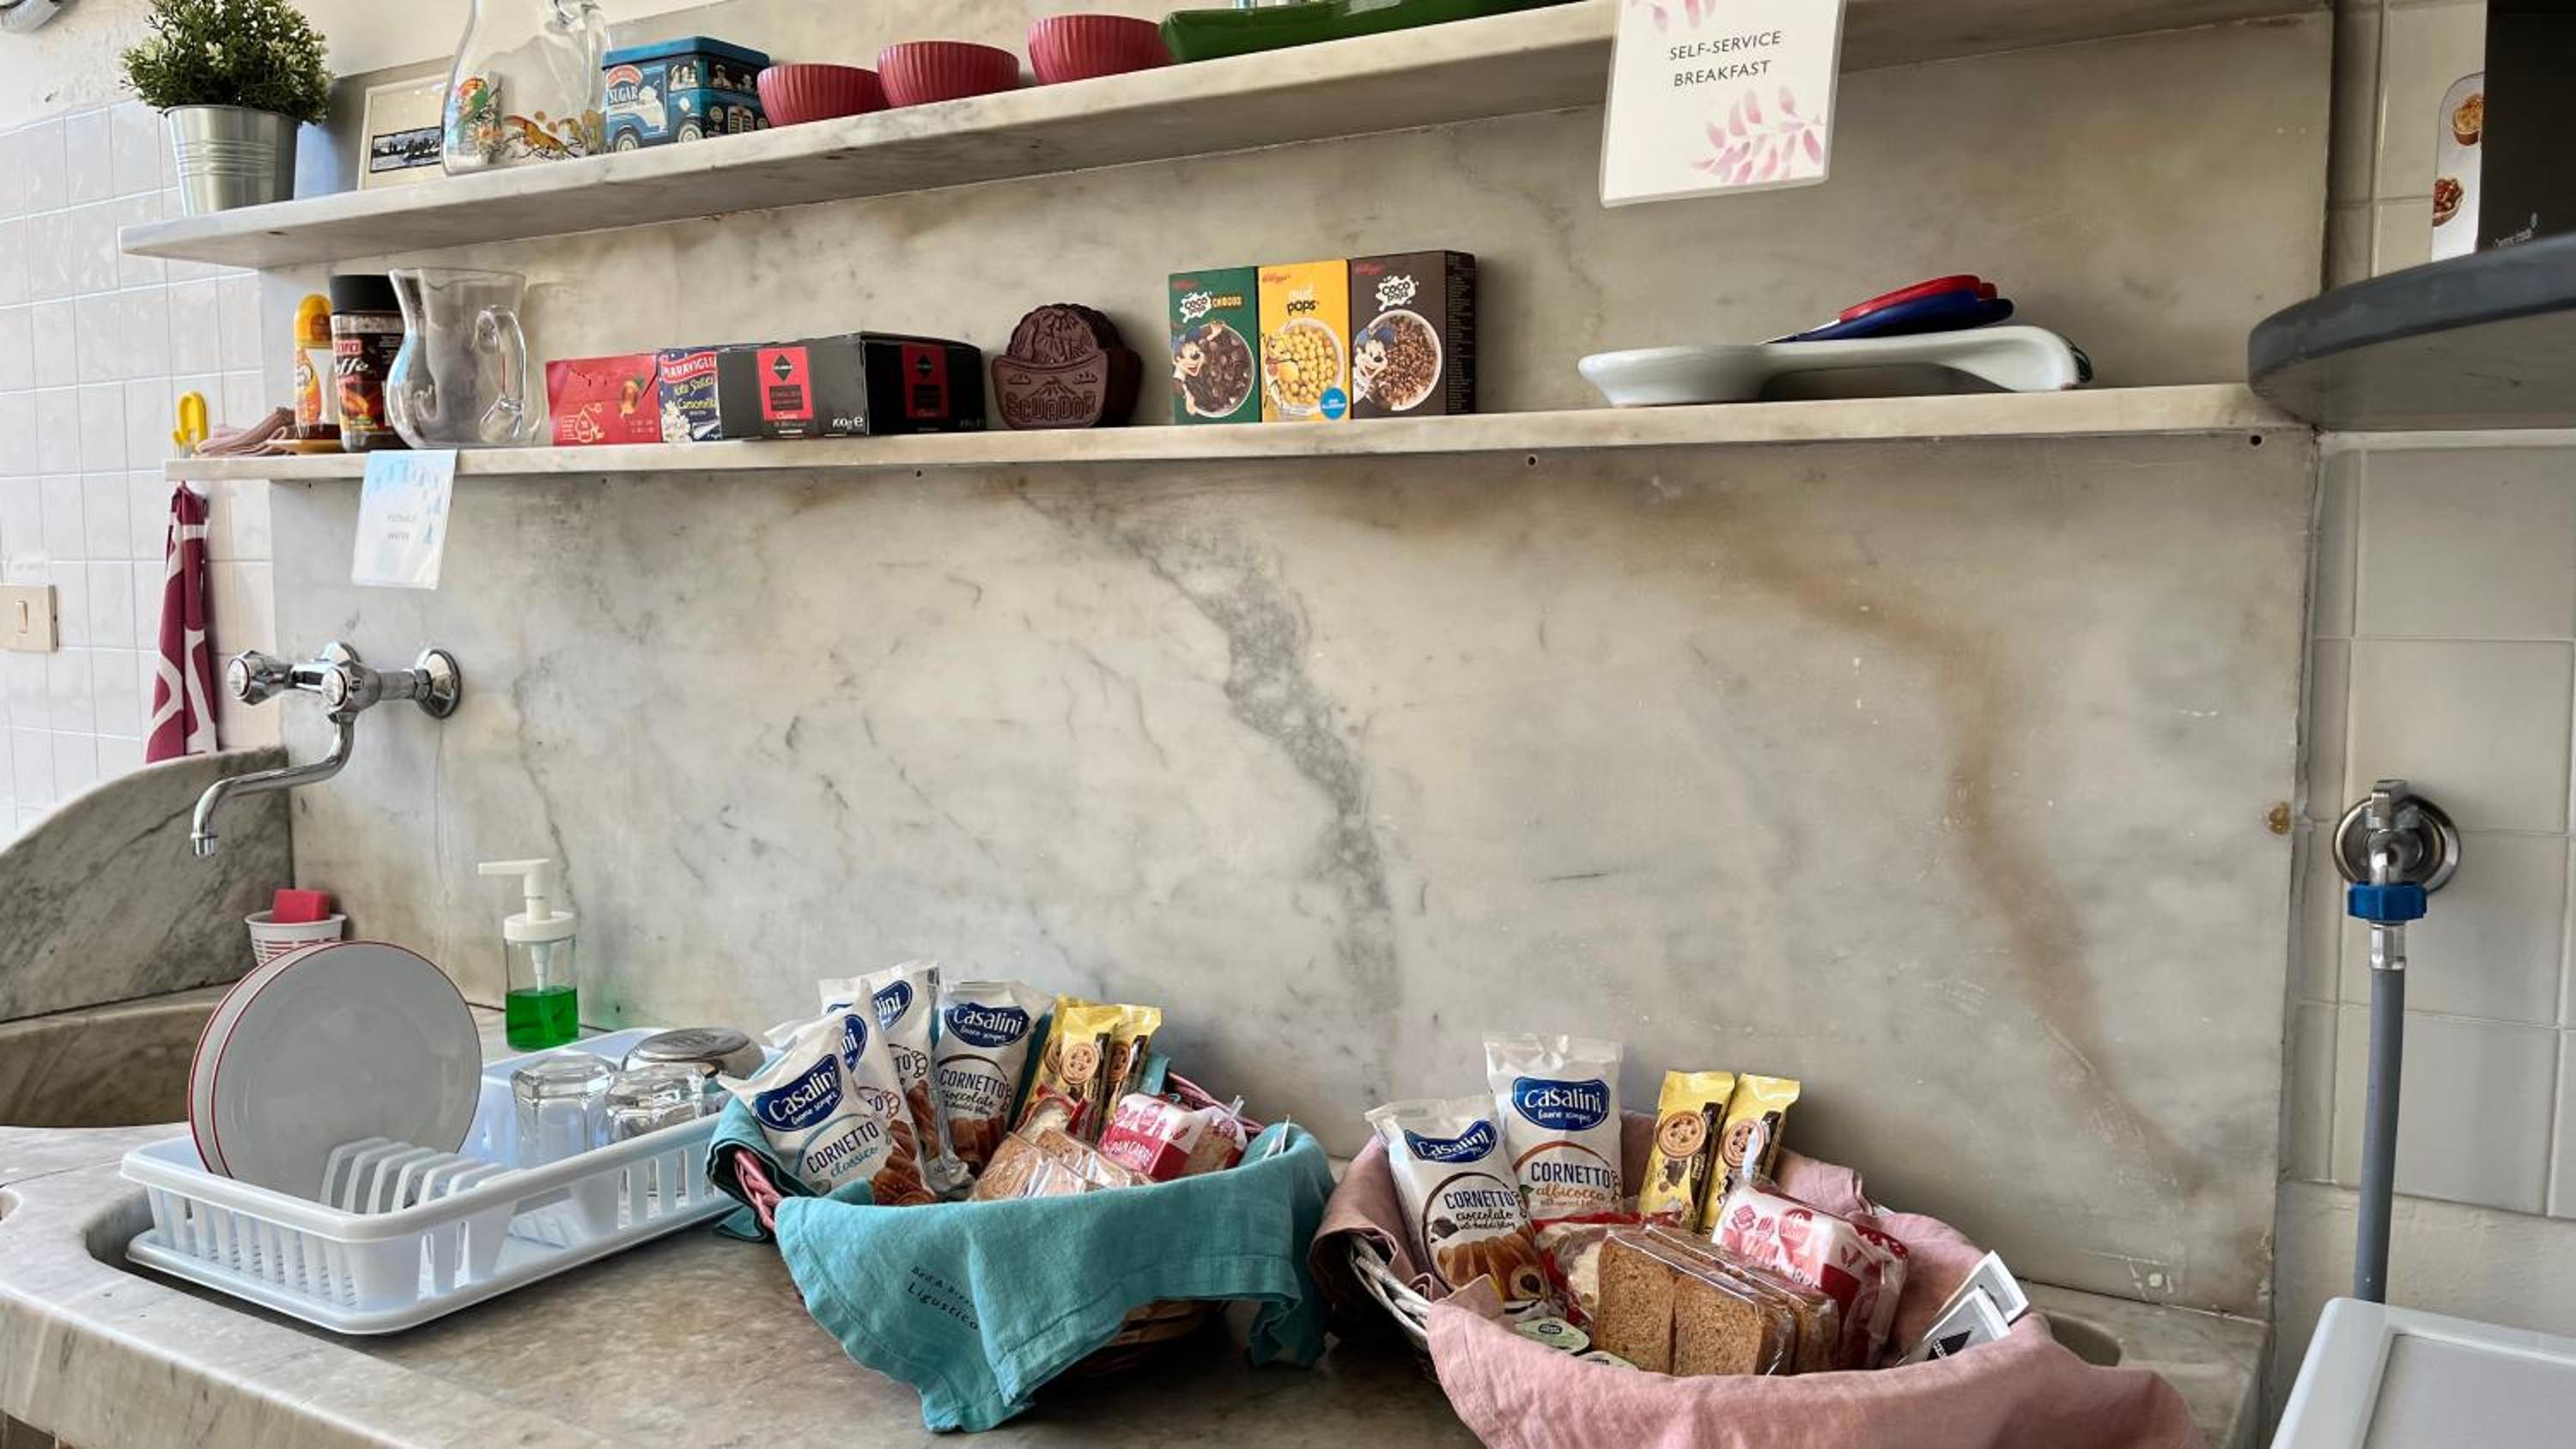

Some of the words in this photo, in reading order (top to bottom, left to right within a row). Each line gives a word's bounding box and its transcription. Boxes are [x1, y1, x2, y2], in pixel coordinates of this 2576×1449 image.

[1669, 30, 1782, 61] SELF-SERVICE
[1674, 59, 1772, 87] BREAKFAST
[608, 87, 638, 104] SUGAR
[1004, 391, 1097, 423] ECUADOR
[953, 1005, 1024, 1036] Casalini
[769, 1065, 839, 1122] Casalini
[939, 1069, 1005, 1098] CORNETTO
[1523, 1087, 1602, 1113] Casalini
[805, 1121, 879, 1173] CORNETTO
[1417, 1127, 1490, 1157] Casalini
[1530, 1161, 1610, 1189] CORNETTO
[1443, 1190, 1516, 1210] CORNETTO
[1536, 1181, 1607, 1202] albicocca
[907, 1281, 979, 1331] Ligustico
